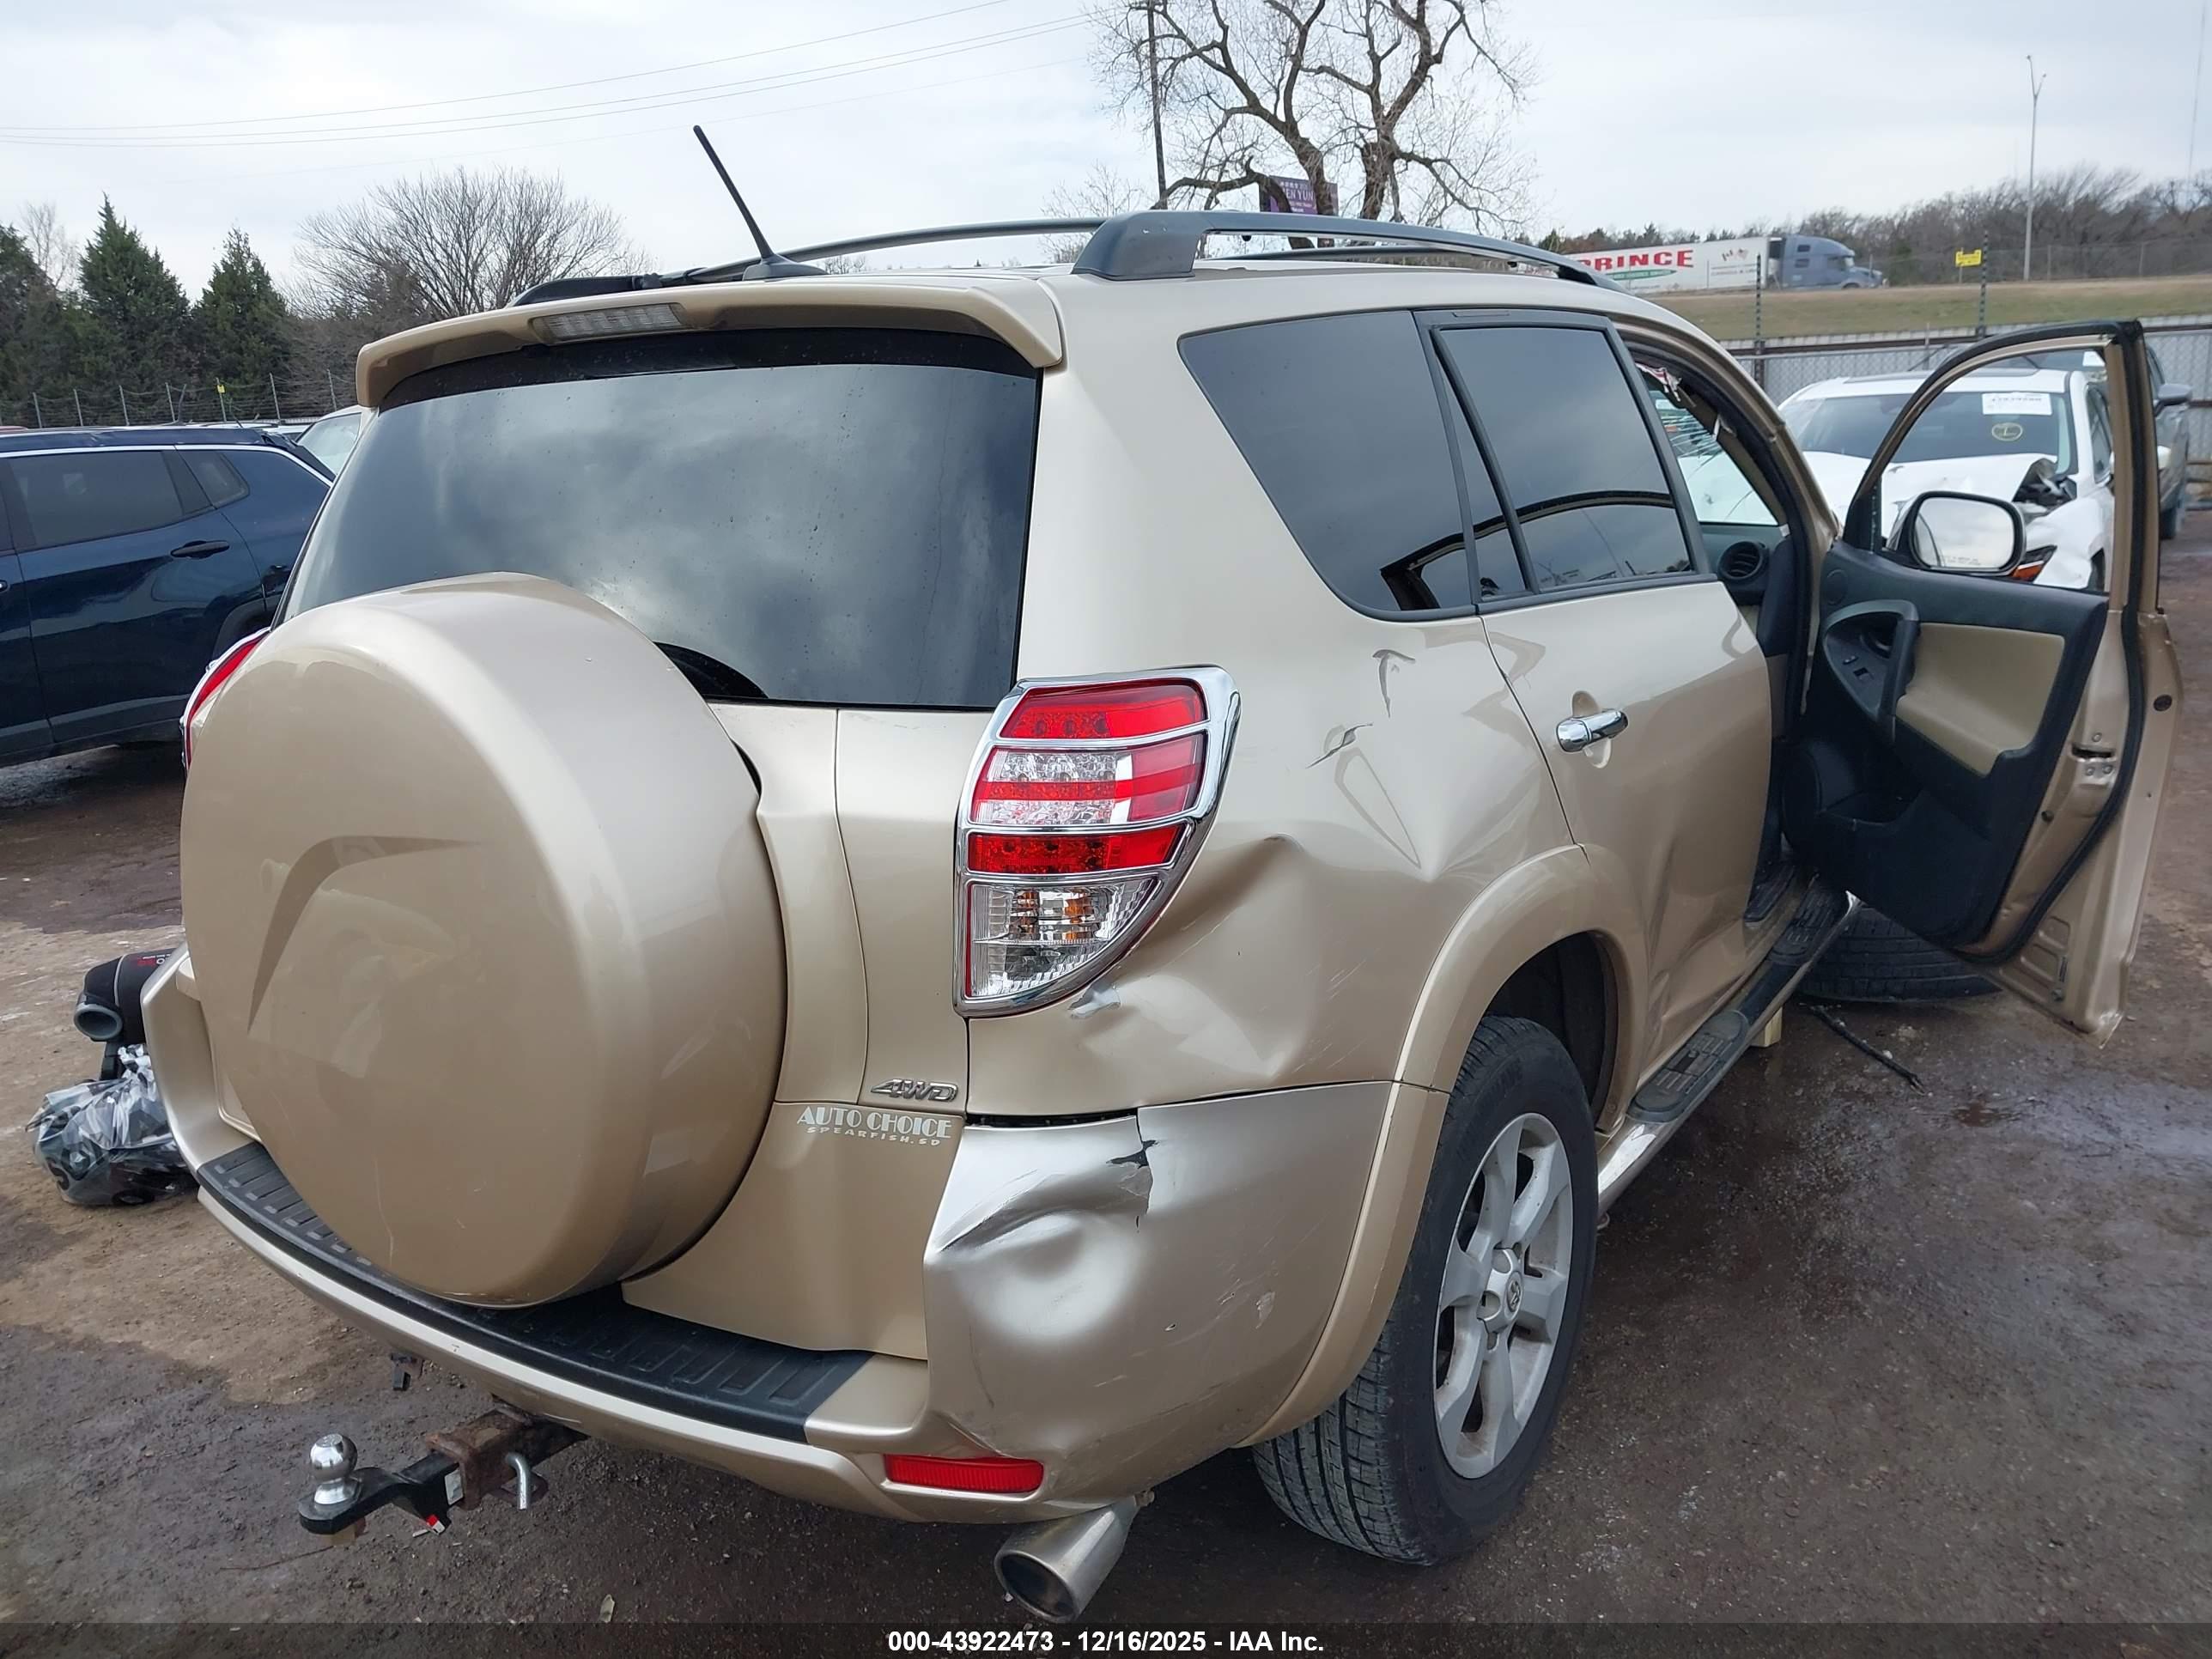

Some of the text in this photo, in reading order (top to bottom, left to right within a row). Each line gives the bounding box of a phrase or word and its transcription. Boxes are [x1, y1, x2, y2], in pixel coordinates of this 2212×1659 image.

[870, 1079, 958, 1103] 4WD
[797, 1106, 952, 1139] AUTO CHOICE
